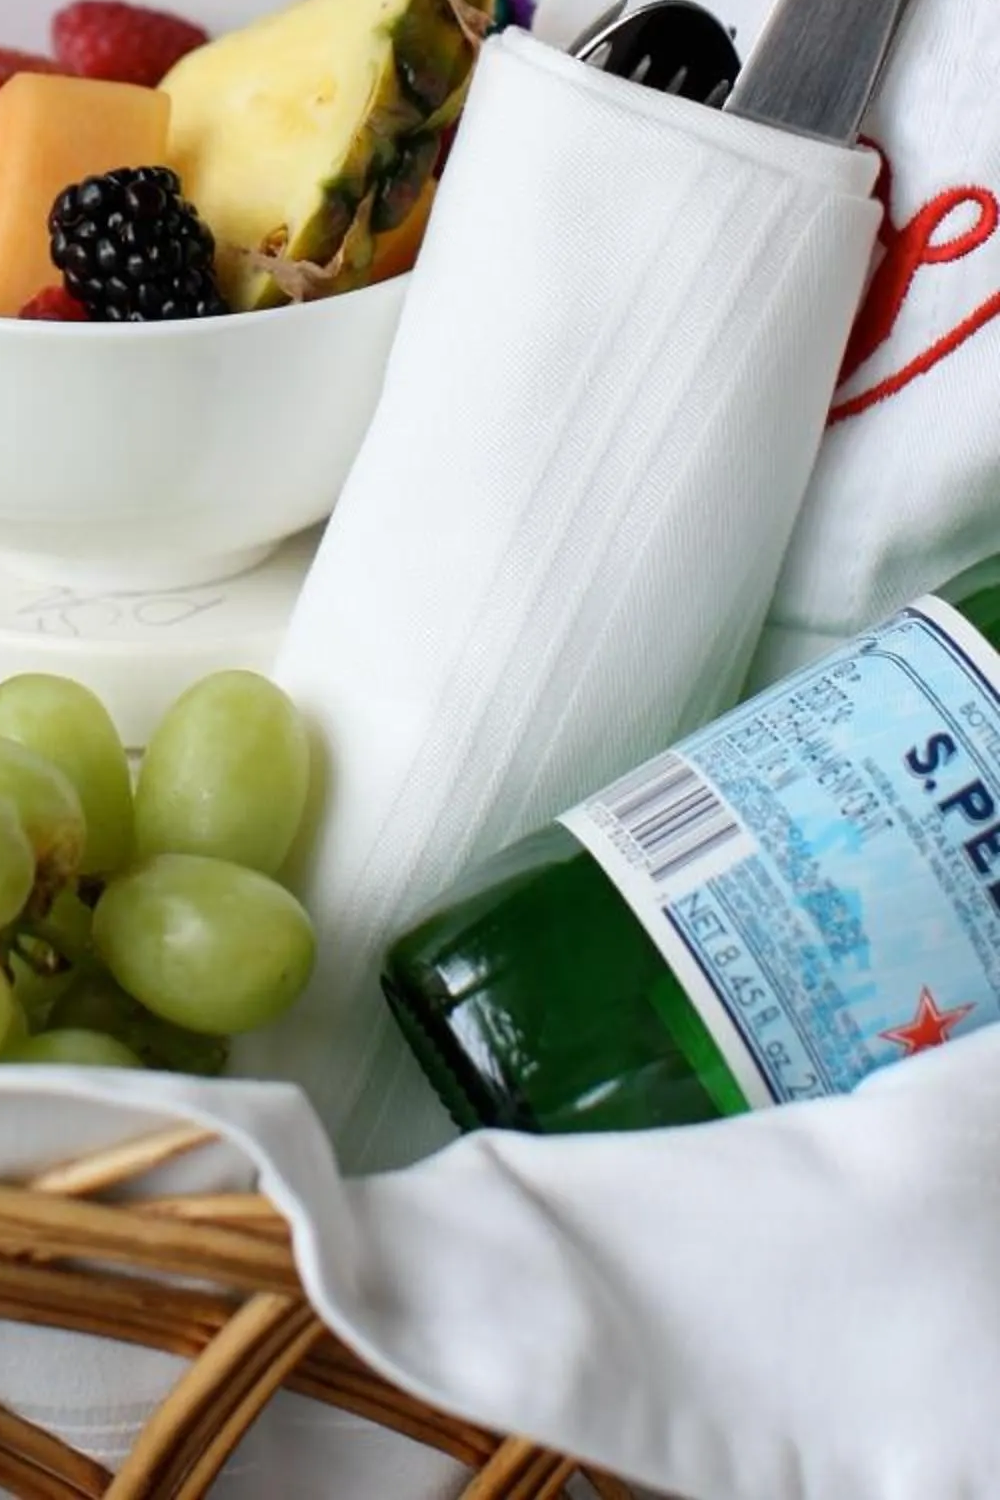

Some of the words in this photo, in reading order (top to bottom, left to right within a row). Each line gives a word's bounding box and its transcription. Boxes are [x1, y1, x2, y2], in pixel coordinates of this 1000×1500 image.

[959, 699, 1000, 767] BOTTL
[676, 891, 728, 942] NET
[787, 1073, 824, 1102] 2
